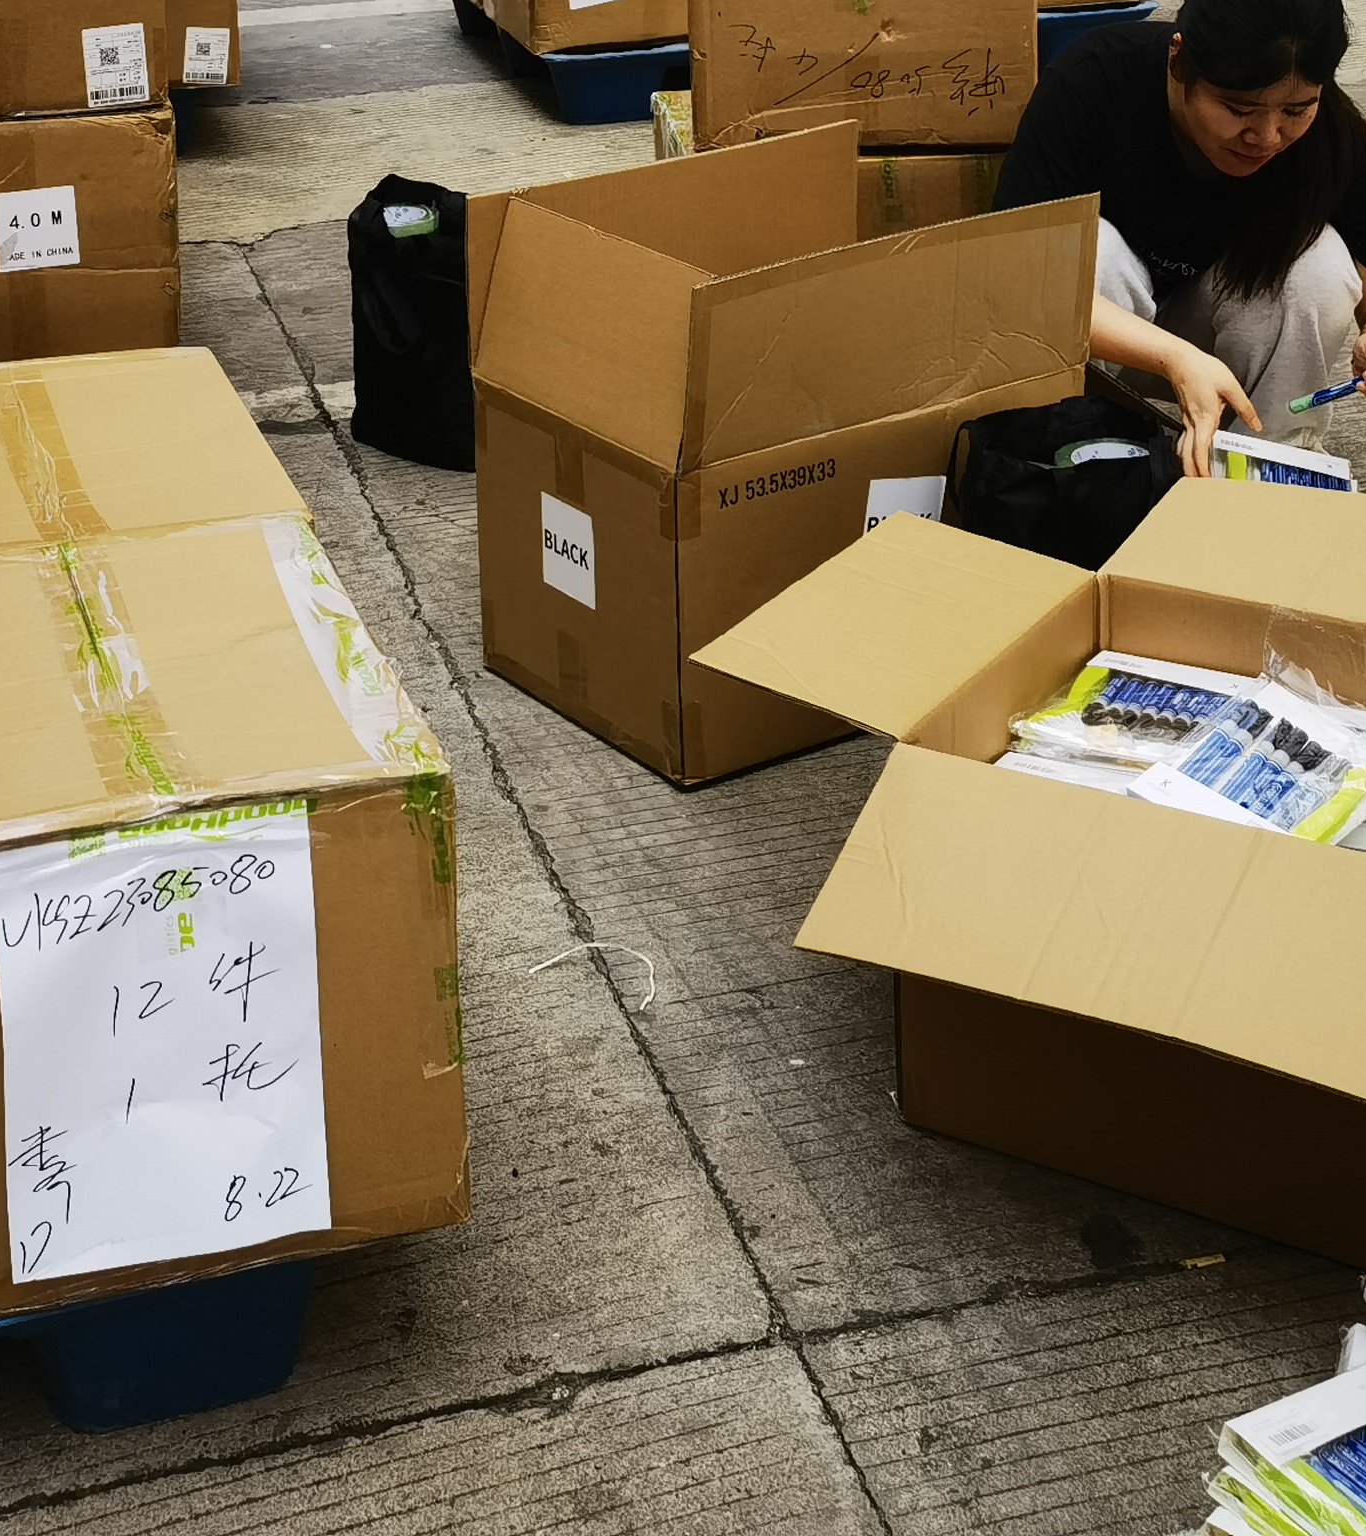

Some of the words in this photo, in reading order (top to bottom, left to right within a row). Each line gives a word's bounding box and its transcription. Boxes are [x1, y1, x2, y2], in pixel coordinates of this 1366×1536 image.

[8, 212, 41, 229] 4.0
[51, 209, 62, 226] M
[1, 251, 26, 262] ADE
[46, 246, 75, 257] CHINA
[718, 484, 739, 510] XJ
[745, 458, 836, 501] 53.5X39X33
[544, 528, 590, 571] BLACK
[112, 980, 177, 1038] 12
[223, 1167, 314, 1223] 8.22
